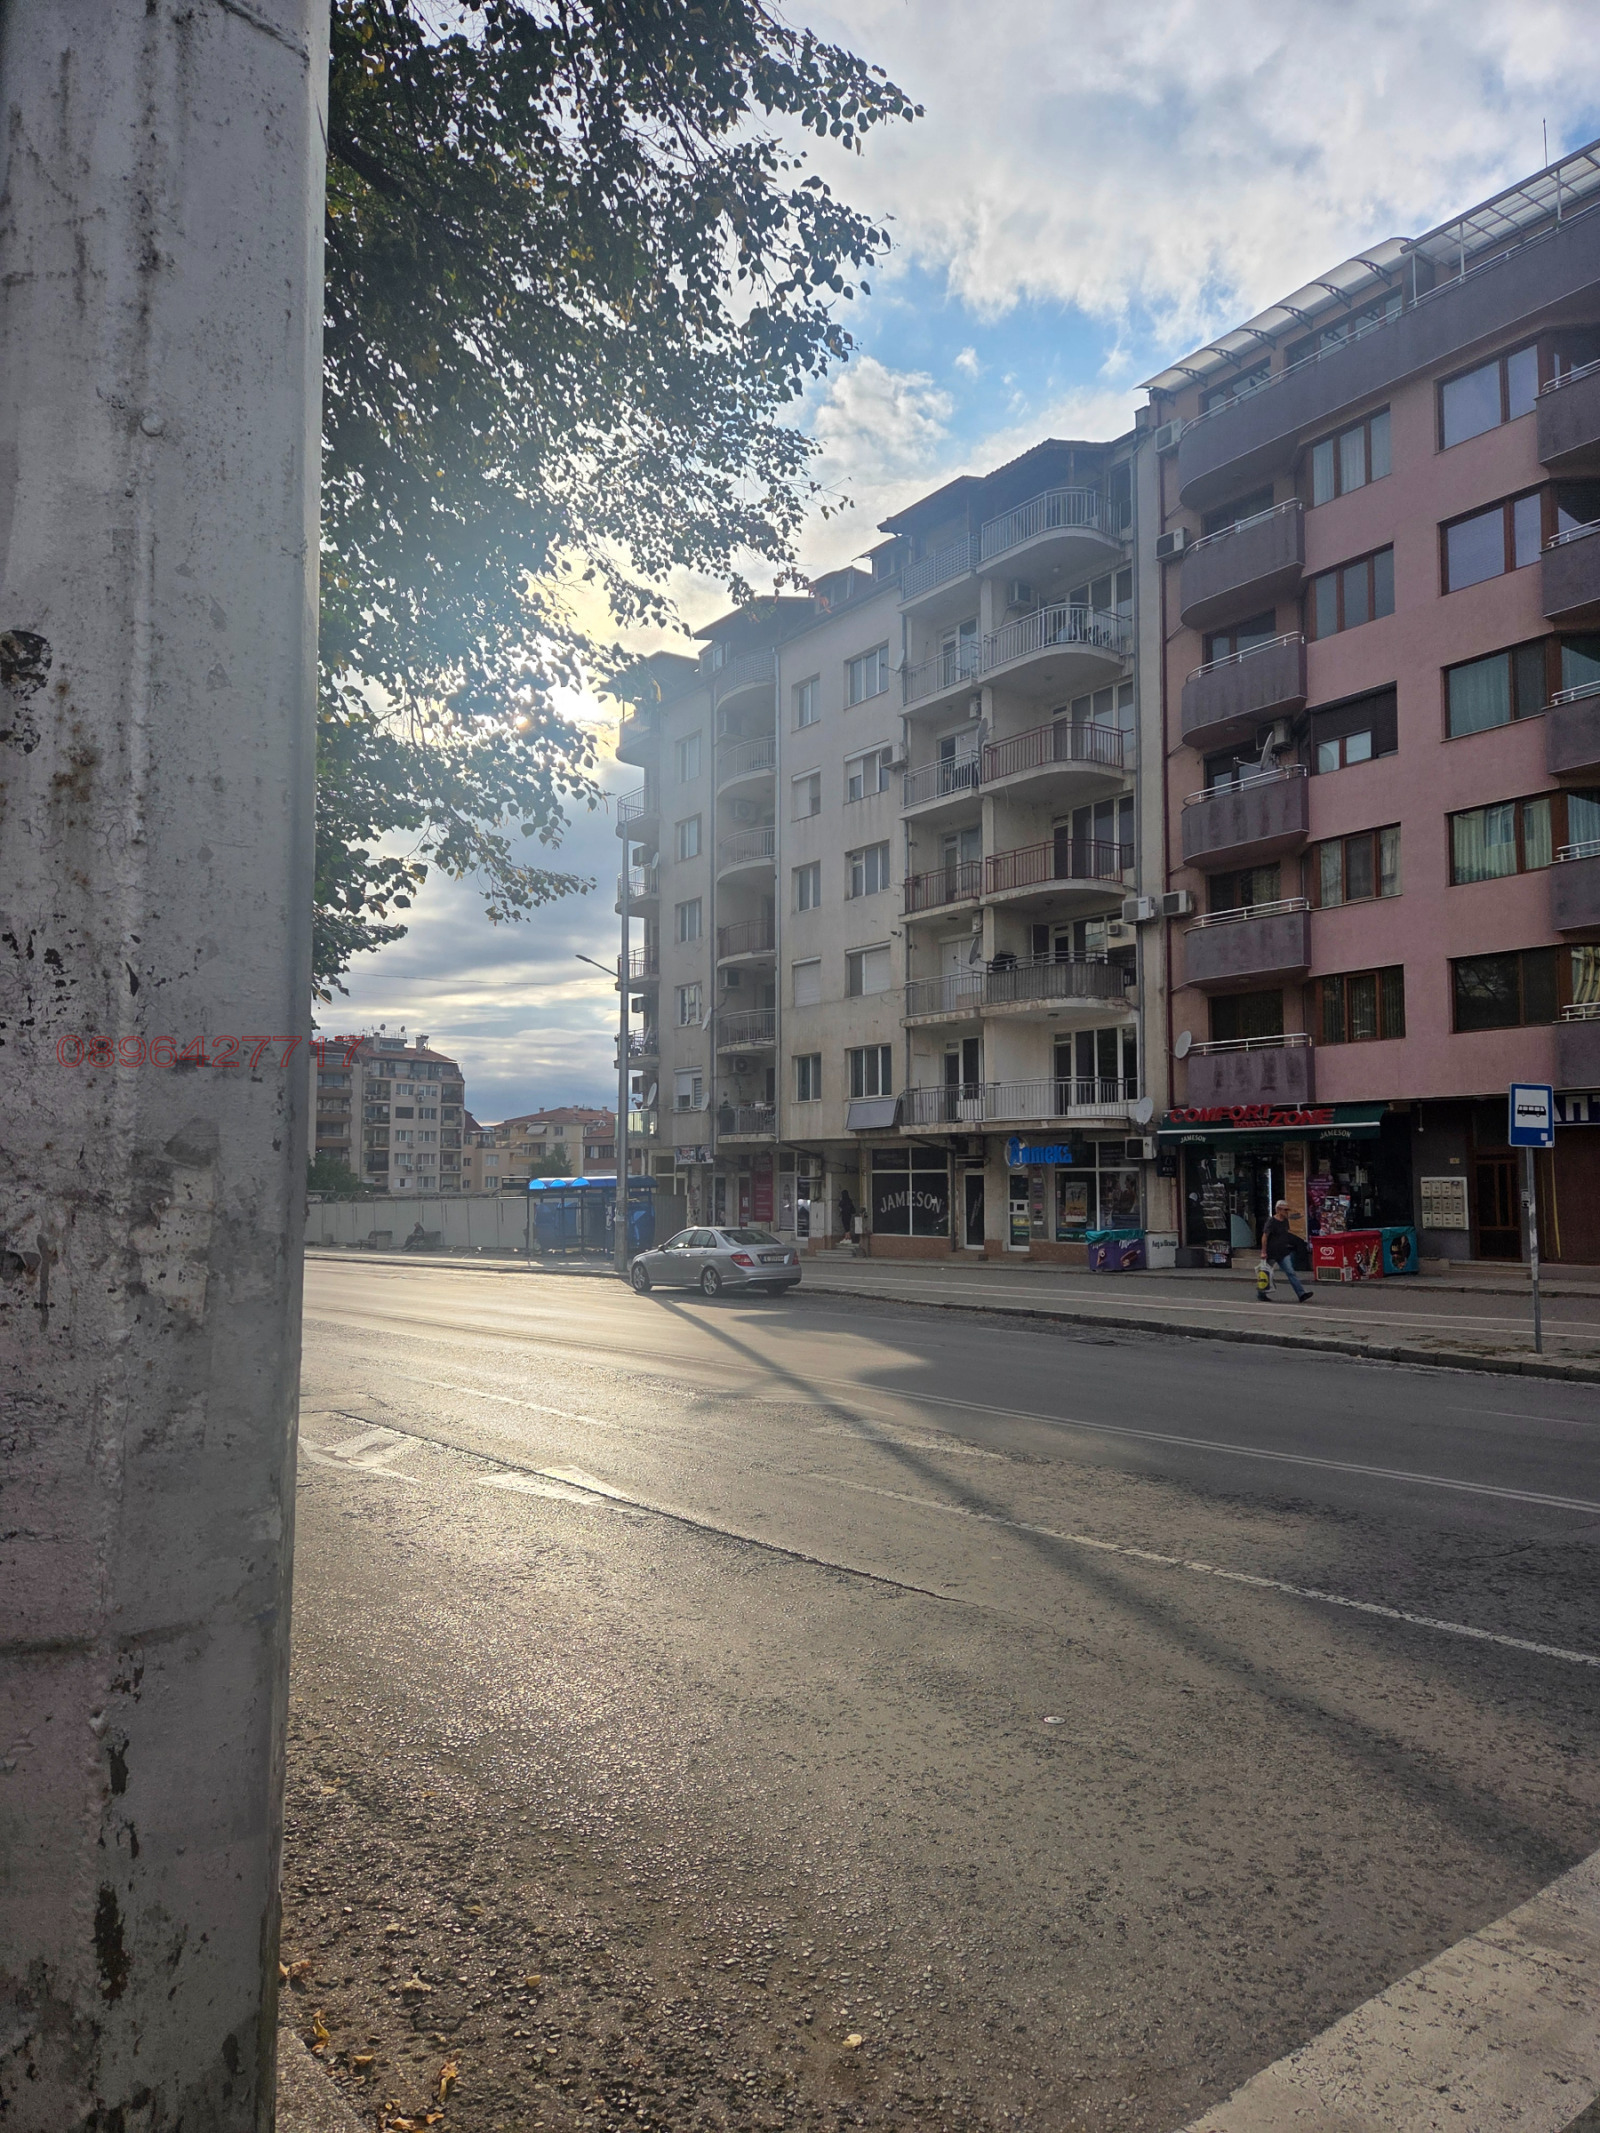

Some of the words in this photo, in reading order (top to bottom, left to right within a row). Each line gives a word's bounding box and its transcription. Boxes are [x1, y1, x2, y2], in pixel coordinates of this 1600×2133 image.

[1170, 1104, 1273, 1123] COMFORT
[1269, 1108, 1335, 1126] ZONE
[1179, 1134, 1207, 1144] JAMESON
[1319, 1128, 1352, 1140] JAMESON
[880, 1191, 943, 1214] JAMESON
